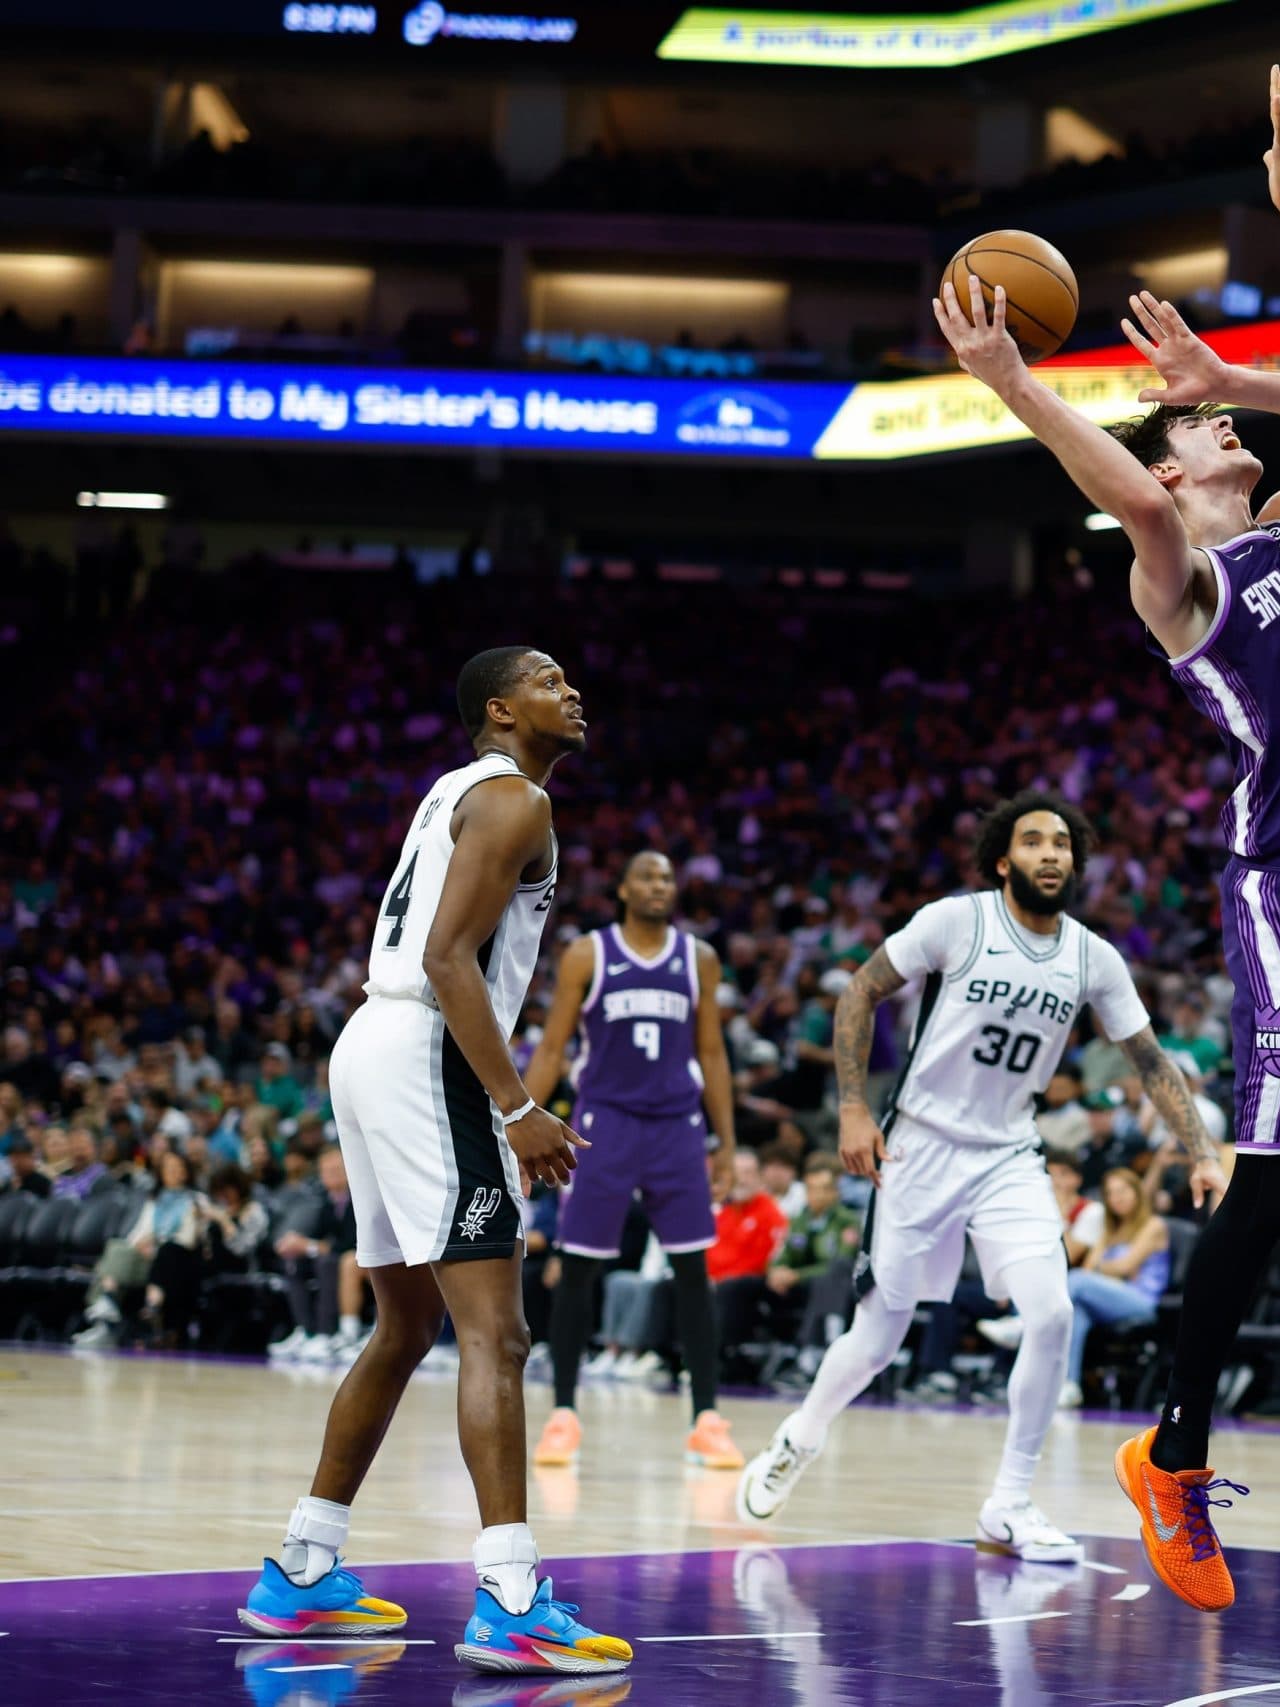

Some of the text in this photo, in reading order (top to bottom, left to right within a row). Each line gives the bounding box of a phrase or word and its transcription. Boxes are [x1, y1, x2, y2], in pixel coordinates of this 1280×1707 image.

[48, 373, 221, 419] donated
[227, 378, 275, 421] to
[279, 380, 349, 431] My
[354, 384, 519, 429] Sister's
[524, 390, 657, 434] House
[380, 845, 422, 952] 4
[966, 979, 1073, 1025] SPURS
[633, 1022, 660, 1061] 9
[972, 1023, 1042, 1074] 30
